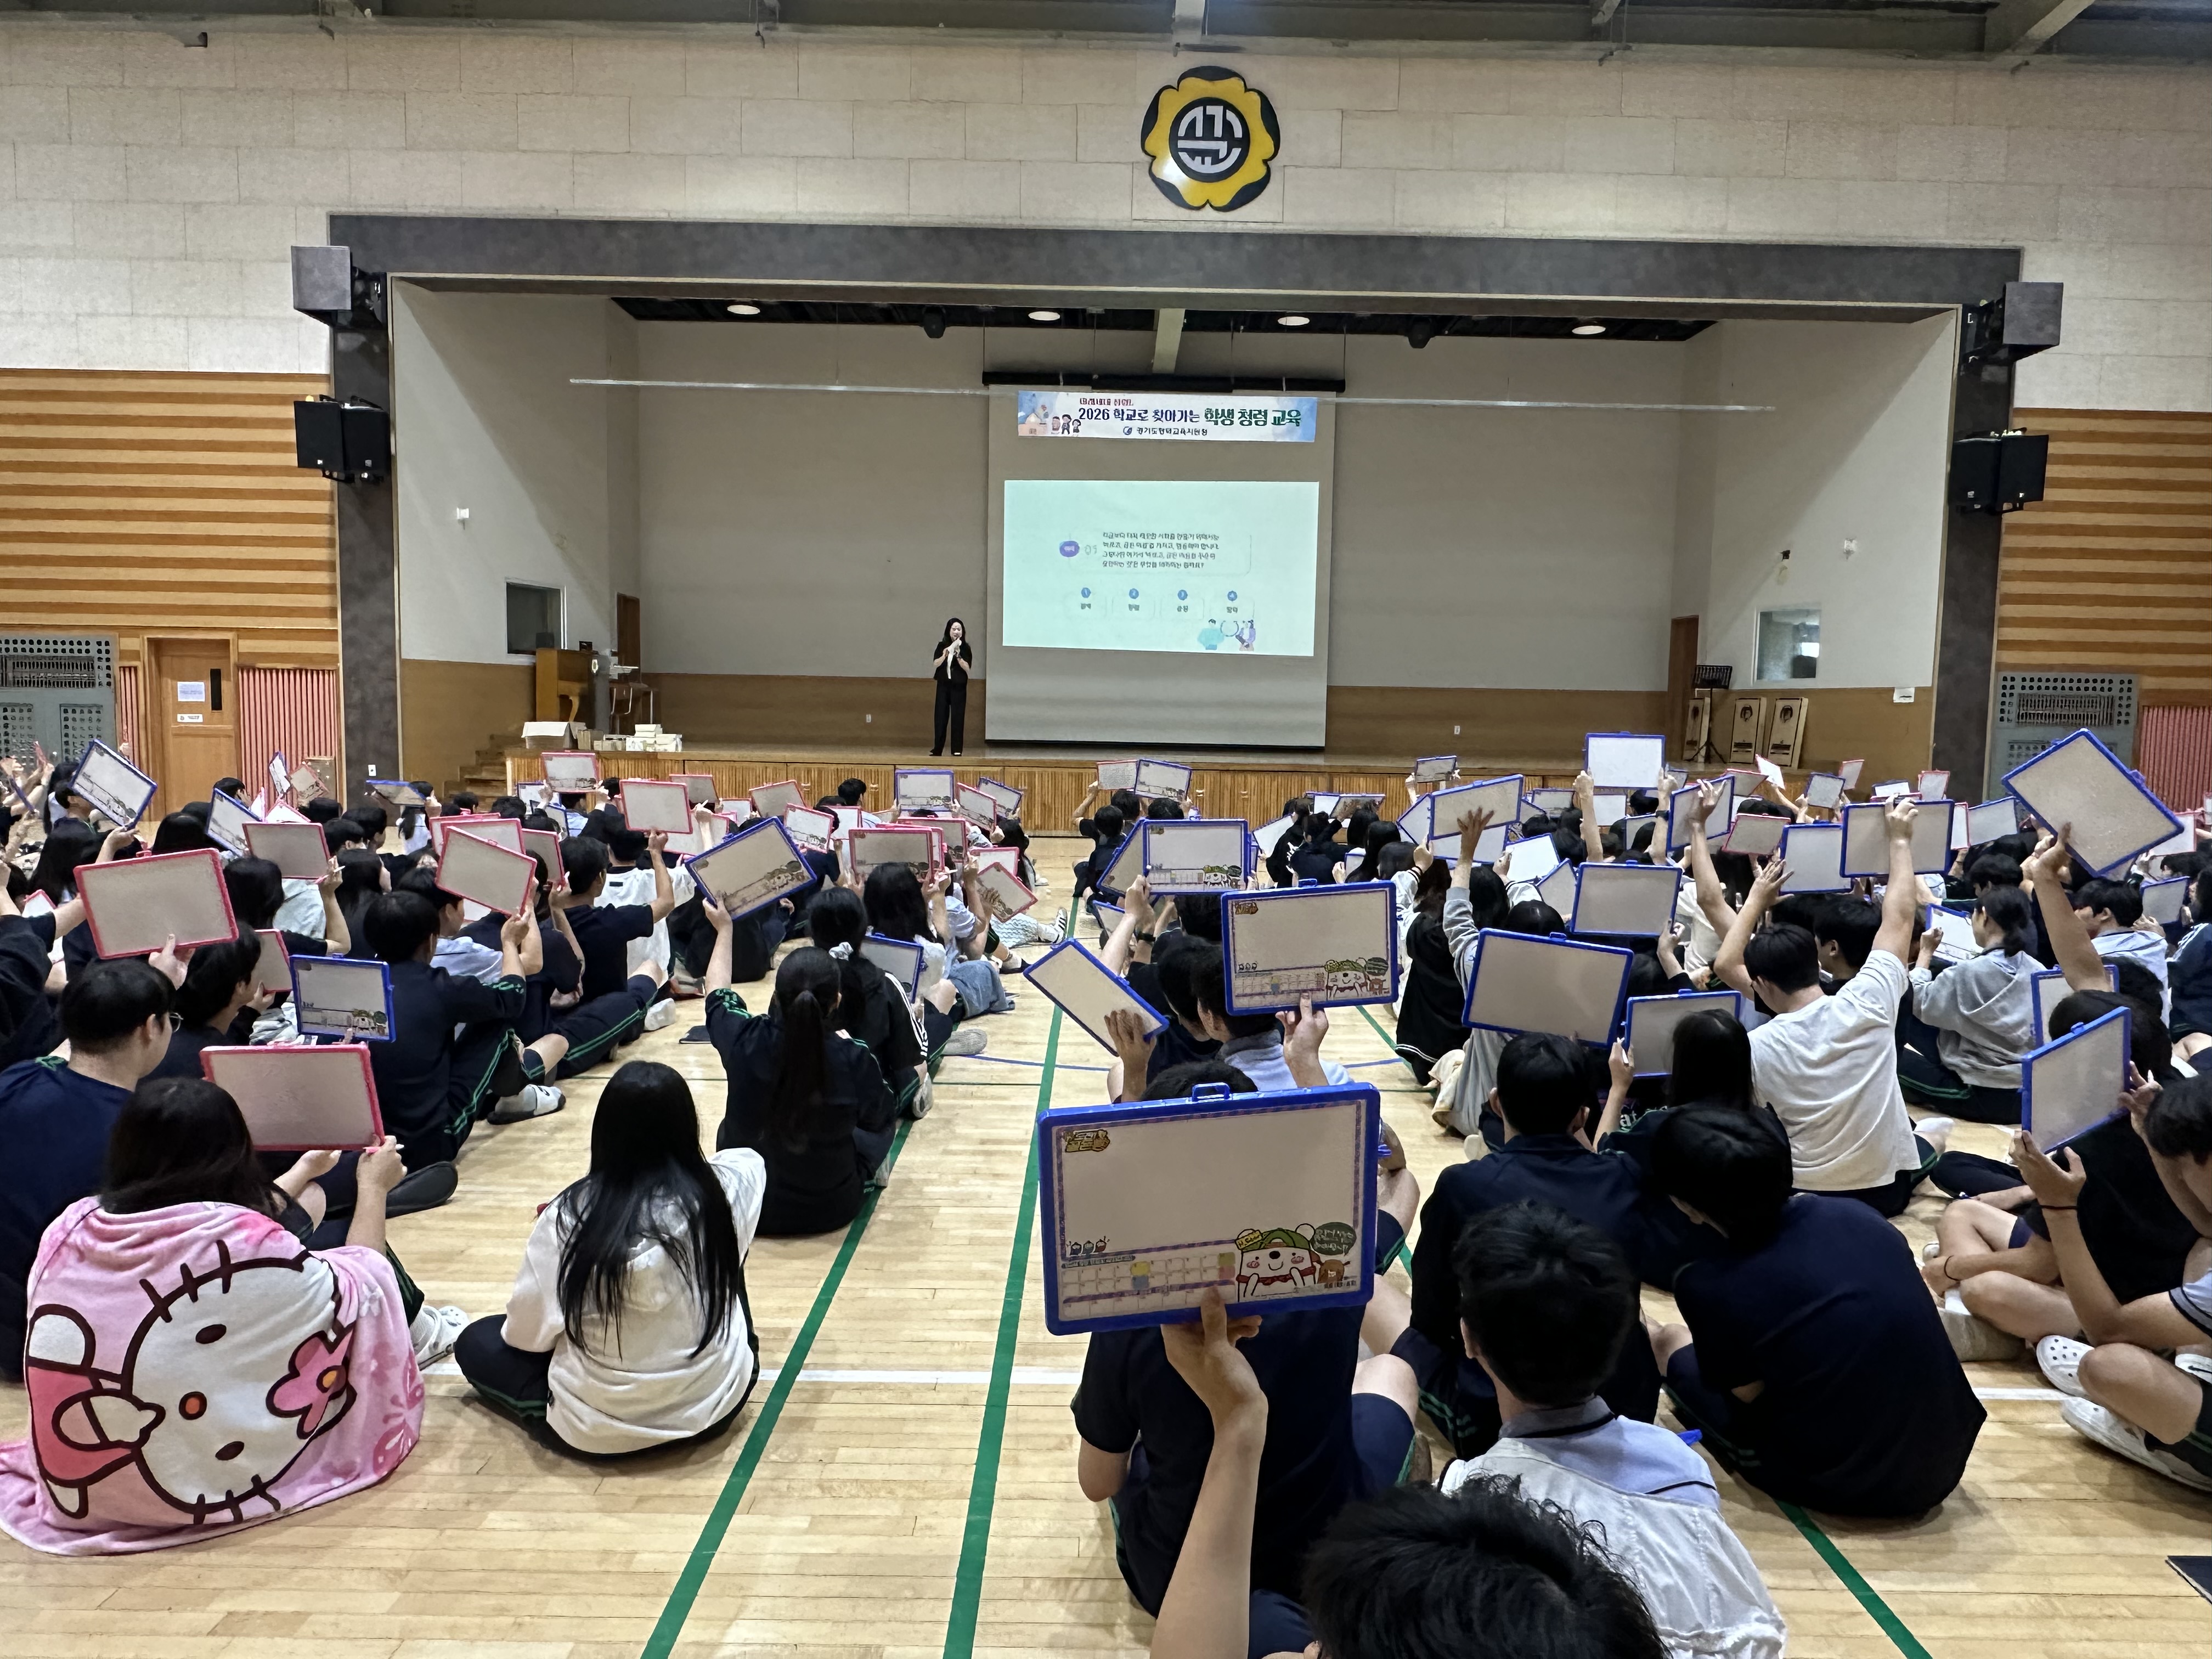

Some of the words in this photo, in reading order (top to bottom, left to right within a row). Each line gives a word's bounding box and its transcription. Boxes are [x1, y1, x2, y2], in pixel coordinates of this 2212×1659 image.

[1079, 408, 1110, 420] 2026
[1114, 409, 1149, 421] 학교로
[1204, 408, 1234, 426] 학생
[1272, 410, 1301, 426] 교육
